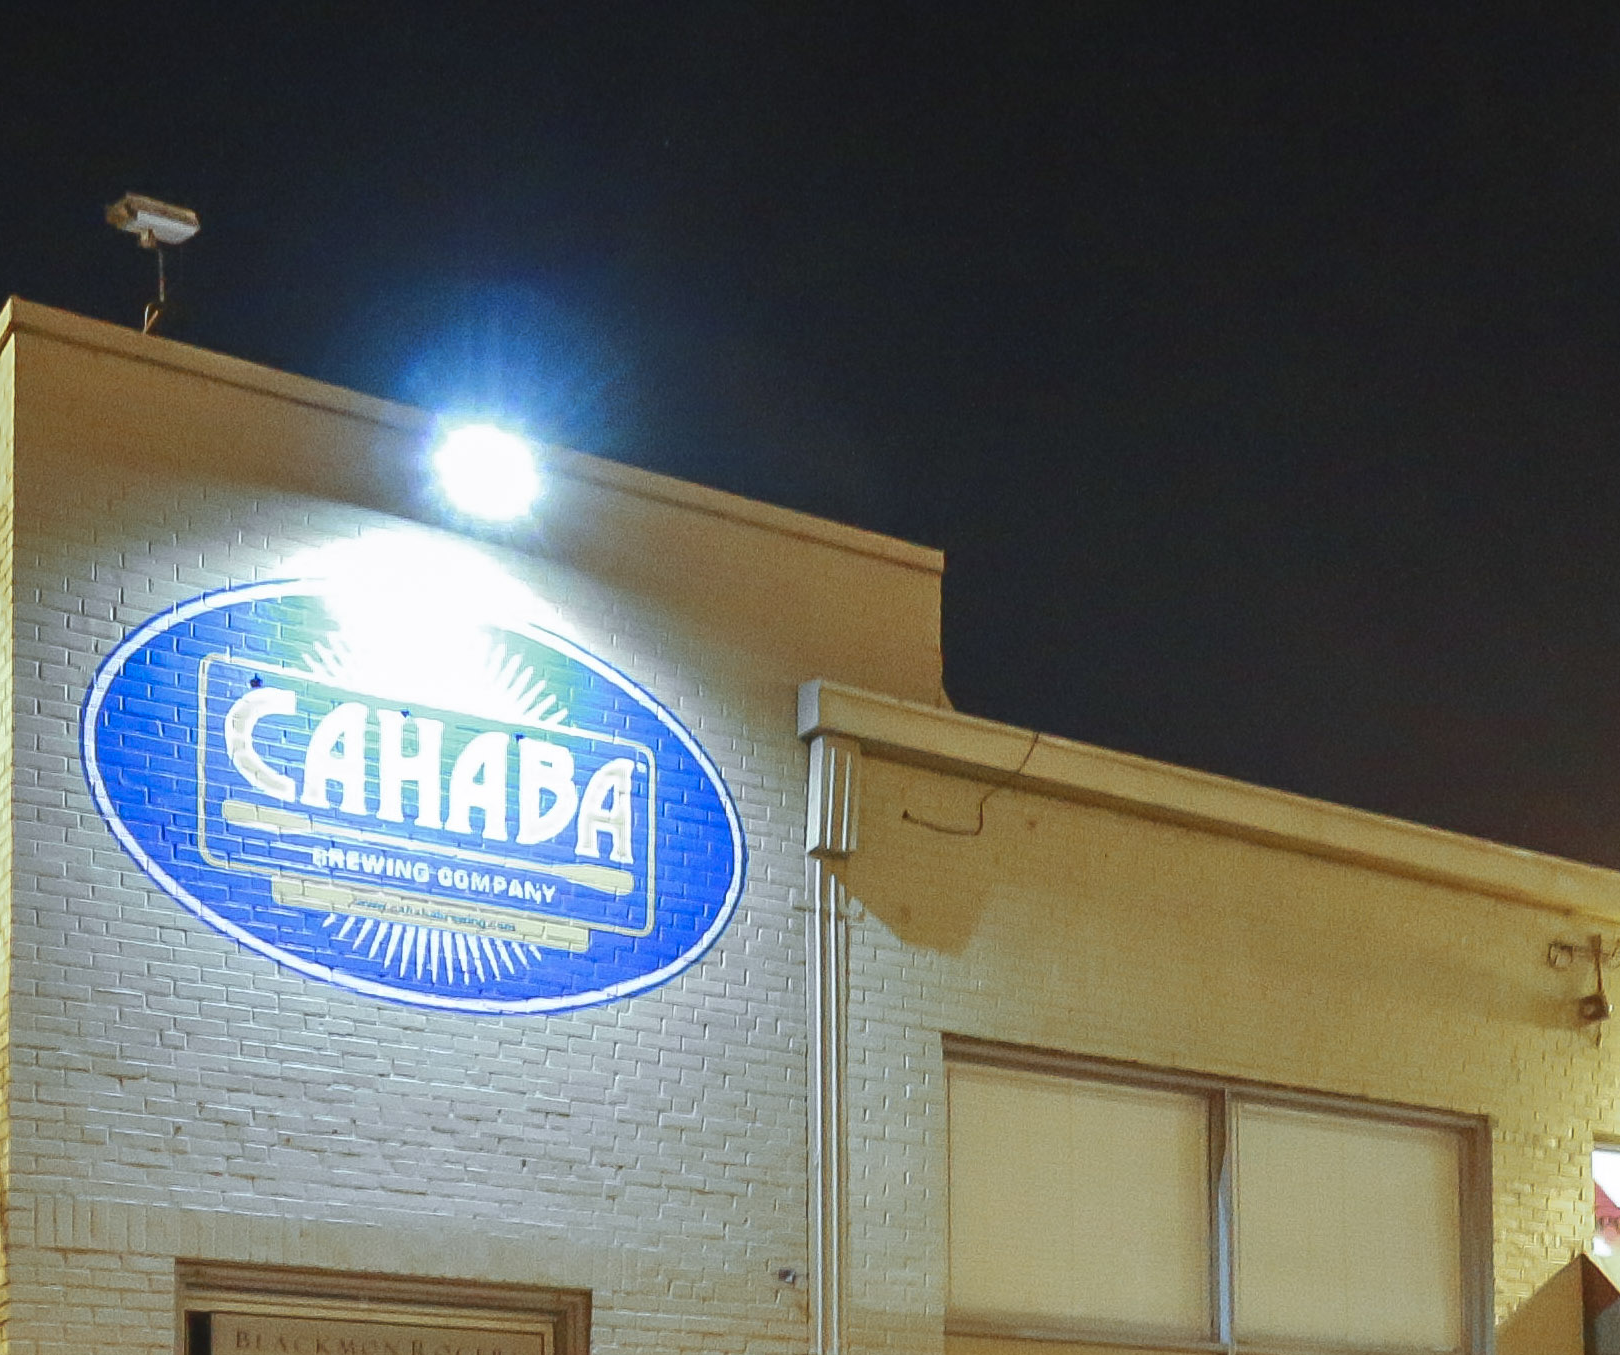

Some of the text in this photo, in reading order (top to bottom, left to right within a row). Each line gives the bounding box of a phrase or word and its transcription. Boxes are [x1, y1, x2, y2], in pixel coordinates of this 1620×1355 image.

[224, 687, 635, 864] CAHABA
[312, 846, 557, 904] BREWING COMPANY
